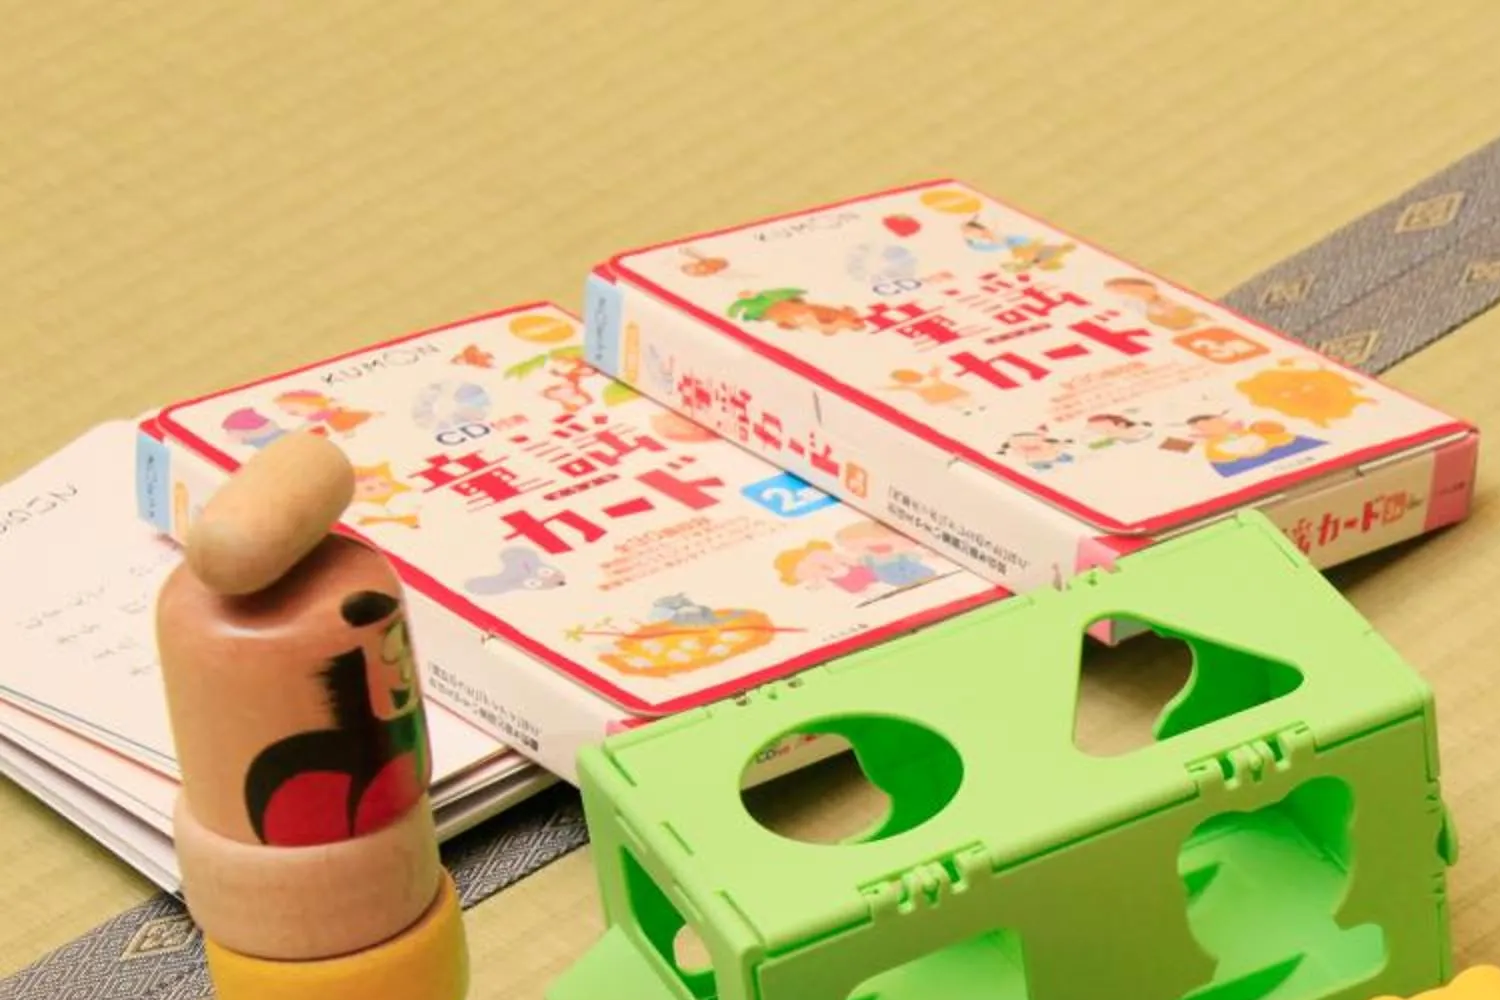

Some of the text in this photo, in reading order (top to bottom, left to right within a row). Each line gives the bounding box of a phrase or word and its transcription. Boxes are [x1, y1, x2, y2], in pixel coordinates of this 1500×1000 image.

[862, 271, 1092, 352] 童話
[872, 277, 923, 297] CD
[319, 341, 441, 387] KUMON
[947, 308, 1153, 391] カード
[405, 413, 668, 514] 童話
[436, 422, 491, 447] CD
[499, 455, 727, 555] カード
